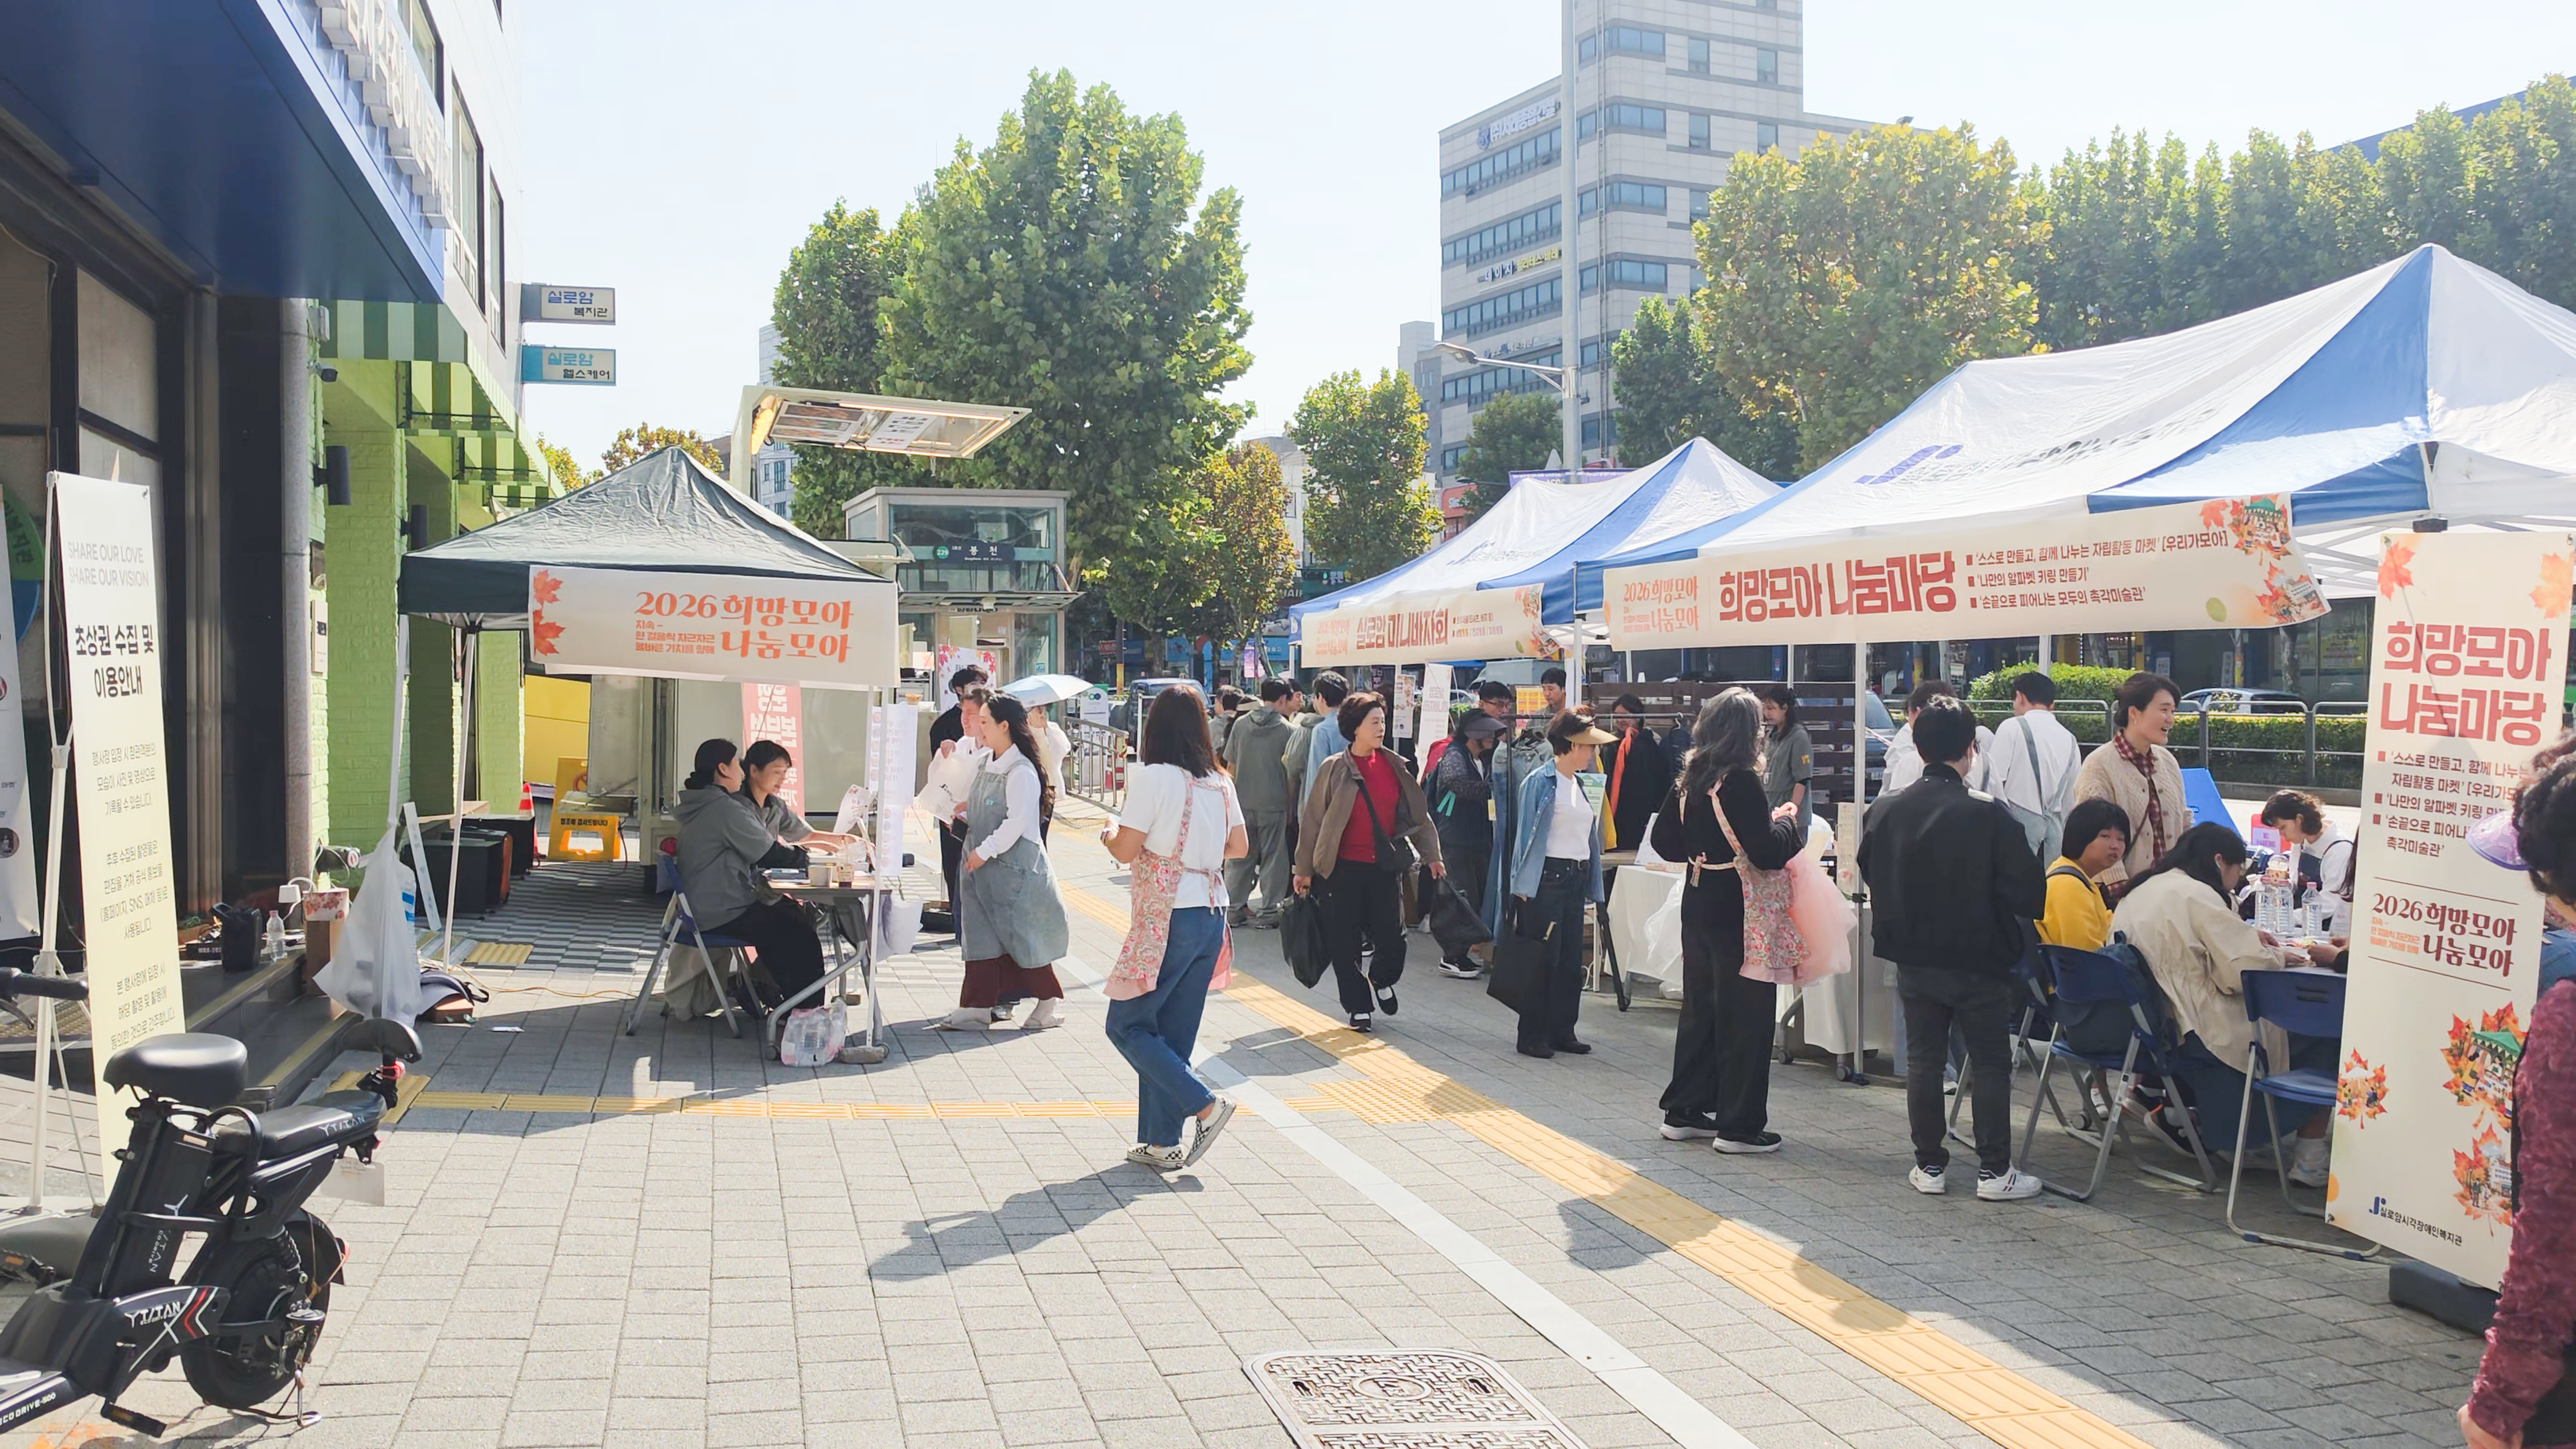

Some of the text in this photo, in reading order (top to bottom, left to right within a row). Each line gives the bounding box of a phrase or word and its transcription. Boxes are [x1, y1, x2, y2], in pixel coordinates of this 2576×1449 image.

[548, 290, 594, 305] 실로암
[574, 307, 608, 317] 복지관
[547, 352, 594, 366] 실로암
[564, 369, 610, 380] 헬스케어
[68, 541, 144, 564] SHARE OUR LOVE
[2006, 548, 2037, 565] 만들고,
[2039, 546, 2058, 562] 함께
[2060, 543, 2090, 560] 나누는
[2092, 539, 2132, 557] 자립활동
[2161, 530, 2229, 553] [우리가모아]
[68, 567, 149, 587] SHARE OUR VISION
[1623, 576, 1699, 604] 2026 희망모아
[1719, 564, 1823, 623] 희망모아
[1826, 551, 1957, 615] 나눔마당
[2007, 570, 2036, 586] 알파벳
[2038, 569, 2057, 584] 키링
[635, 592, 854, 630] 2026 희망모아
[2020, 592, 2056, 608] 피어나는
[2058, 590, 2088, 606] 모두의
[1356, 614, 1385, 649] 실로암
[1388, 608, 1448, 647] 미니바자회
[1651, 605, 1699, 633] 나눔모아
[75, 625, 154, 656] 초상권 수집 및
[636, 631, 645, 640] 한
[720, 629, 852, 663] 나눔모아
[2384, 621, 2552, 682] 희망모아
[94, 665, 142, 698] 이용안내
[2380, 682, 2546, 746] 나눔마당
[92, 748, 110, 766] 행사장
[111, 747, 122, 763] 입장
[2429, 755, 2465, 773] 만들고,
[2469, 760, 2491, 775] 함께
[97, 775, 115, 792] 모습이
[116, 772, 127, 788] 사진
[134, 767, 155, 784] 영상으로
[2392, 772, 2434, 791] 자립활동
[105, 800, 122, 816] 기록될
[123, 798, 129, 812] 수
[2424, 798, 2457, 816] 알파벳
[2460, 803, 2482, 819] 키링
[2433, 822, 2471, 839] 피어나
[106, 852, 117, 867] 추후
[119, 846, 136, 863] 수집된
[104, 875, 122, 895] 편집을
[136, 869, 146, 884] 공식
[2371, 893, 2423, 921] 2026
[2424, 902, 2518, 946] 희망모아
[2423, 934, 2514, 977] 나눔모아
[117, 960, 166, 995] 본 행사장에 입장 시
[118, 985, 167, 1020] 해당 촬영 및 활용에
[111, 1028, 129, 1051] 동의한
[130, 1020, 148, 1040] 것으로
[2381, 1207, 2462, 1246] 실로암시각장애인복지관
